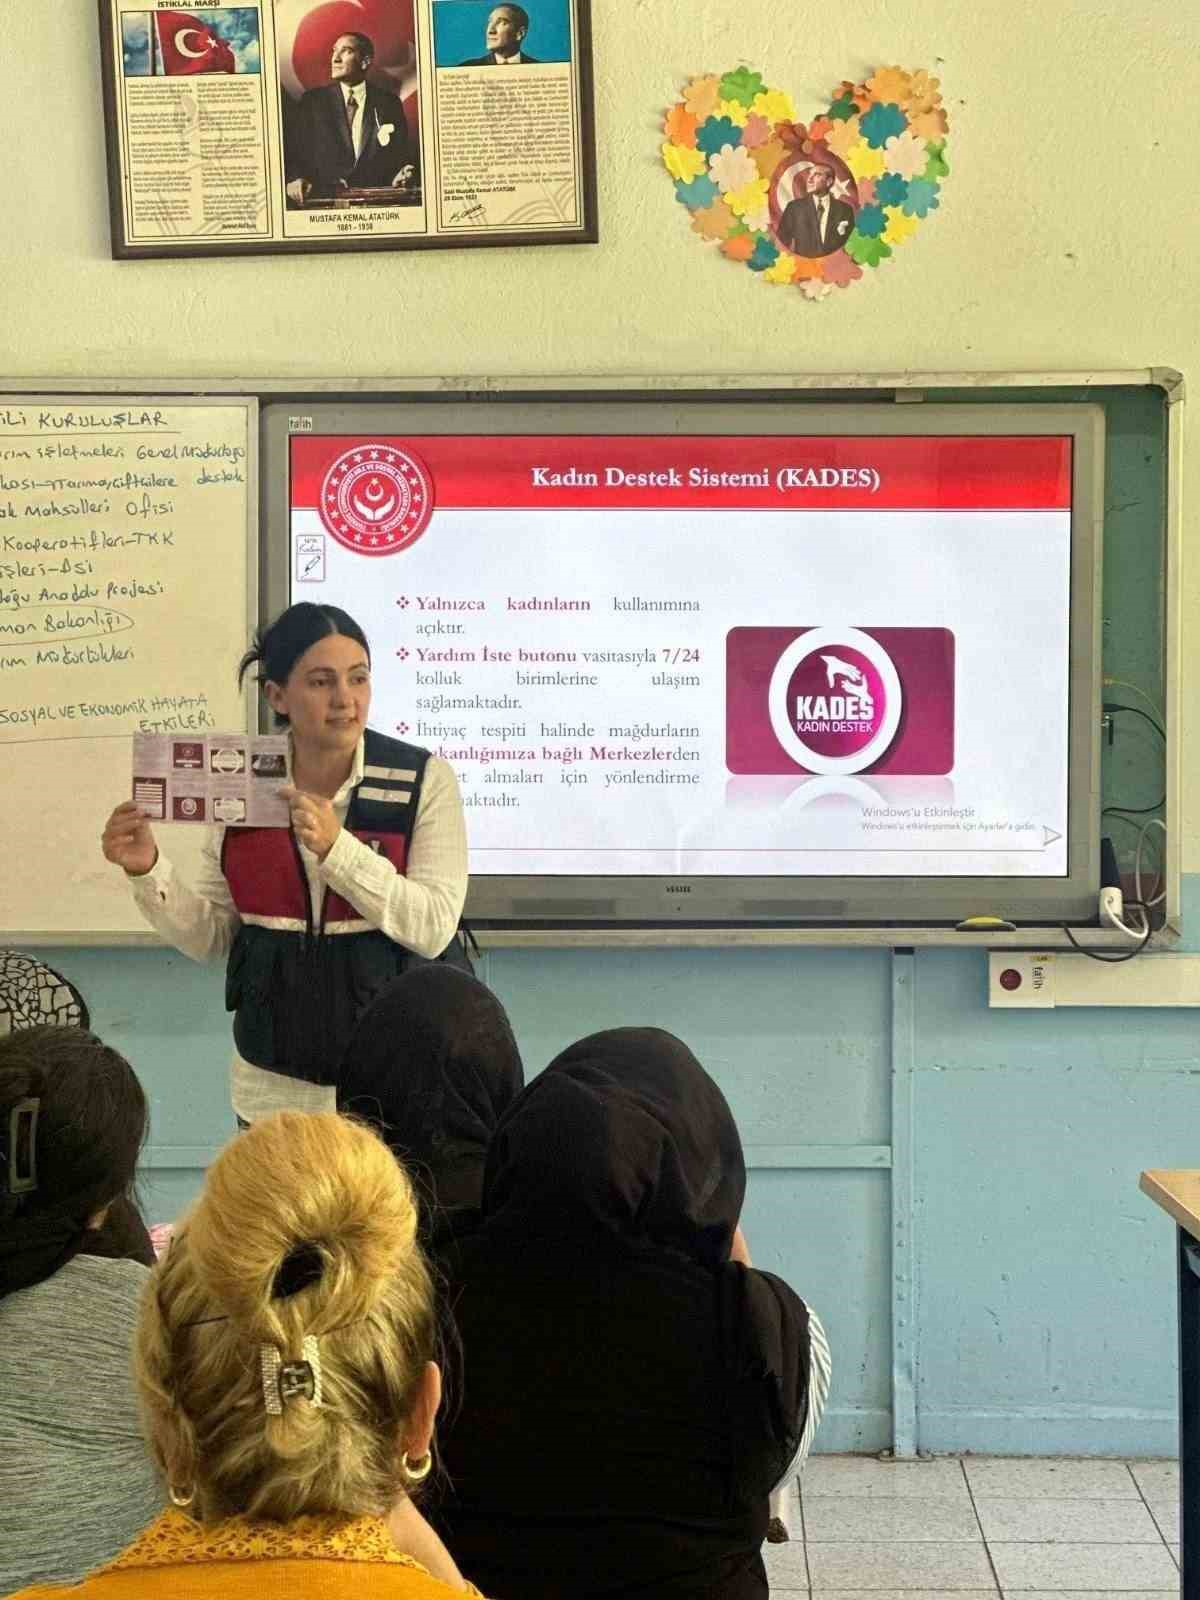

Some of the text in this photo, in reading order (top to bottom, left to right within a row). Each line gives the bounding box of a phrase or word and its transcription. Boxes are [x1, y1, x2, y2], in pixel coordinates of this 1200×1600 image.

[309, 211, 400, 223] MUSTAFA KEMAL ATATÜRK
[337, 224, 352, 232] 1881
[358, 223, 373, 231] 1938
[39, 411, 168, 429] KURULUŞLAR
[136, 444, 179, 460] Genel
[531, 467, 881, 493] Kadın Destek Sistemi (KADES)
[416, 596, 700, 612] Yalnızca kadınların kullanımına
[416, 620, 466, 637] açıktır.
[416, 645, 700, 667] Yardım İste butonu vasıtasıyla 7/24
[416, 670, 700, 689] kolluk birimlerine ulaşım
[416, 694, 523, 713] sağlamaktadır.
[796, 695, 875, 721] KADES
[58, 705, 76, 720] VE
[416, 719, 700, 742] İhtiyaç tespiti halinde mağdurların
[797, 722, 873, 733] KADIN DESTEK
[431, 745, 700, 765] akanlığımıza bağlı Merkezlerden
[484, 768, 543, 784] almaları
[561, 769, 588, 788] için
[605, 768, 700, 788] yönlendirme
[463, 792, 521, 807] aktadır.
[862, 807, 976, 818] Windows'u Etkinleştir
